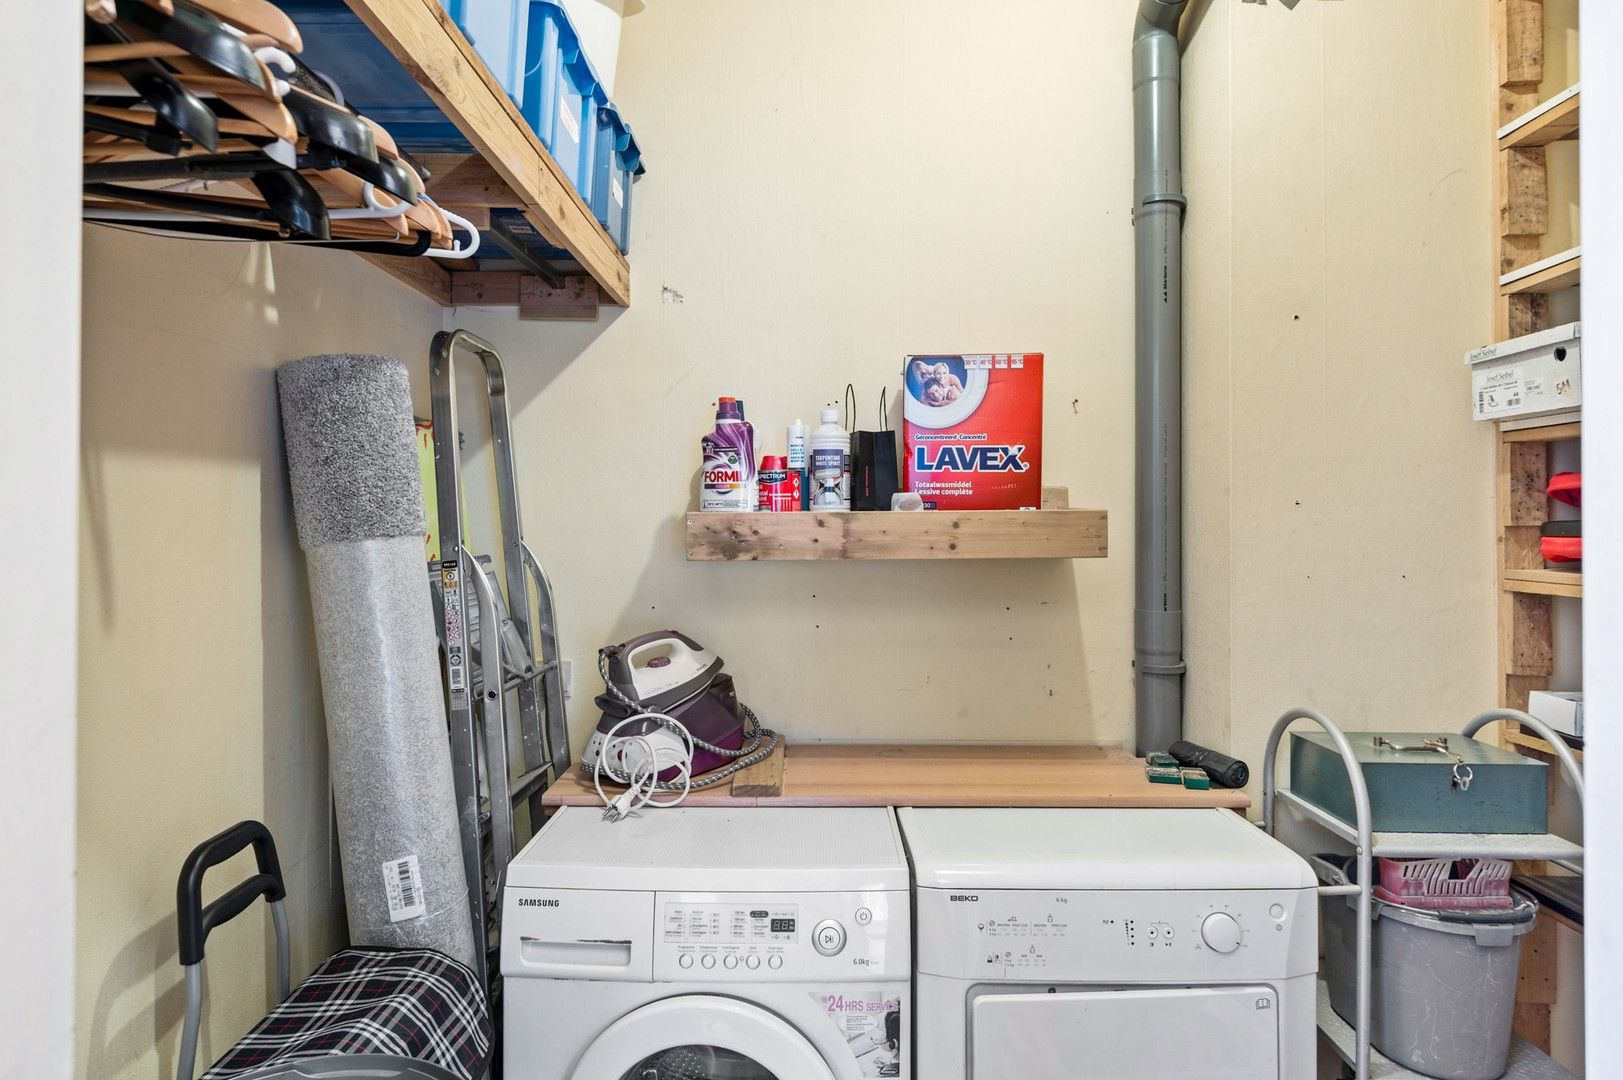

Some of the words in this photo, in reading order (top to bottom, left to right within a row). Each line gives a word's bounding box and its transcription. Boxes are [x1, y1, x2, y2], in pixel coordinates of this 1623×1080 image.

[959, 433, 987, 441] Concentré
[916, 446, 1024, 472] LAVEX
[915, 481, 972, 489] Totaalwasmiddel
[941, 487, 973, 497] complète
[518, 898, 560, 908] SAMSUNG
[853, 958, 870, 967] 6.0kg
[827, 995, 845, 1012] 24
[845, 1000, 864, 1012] HRS
